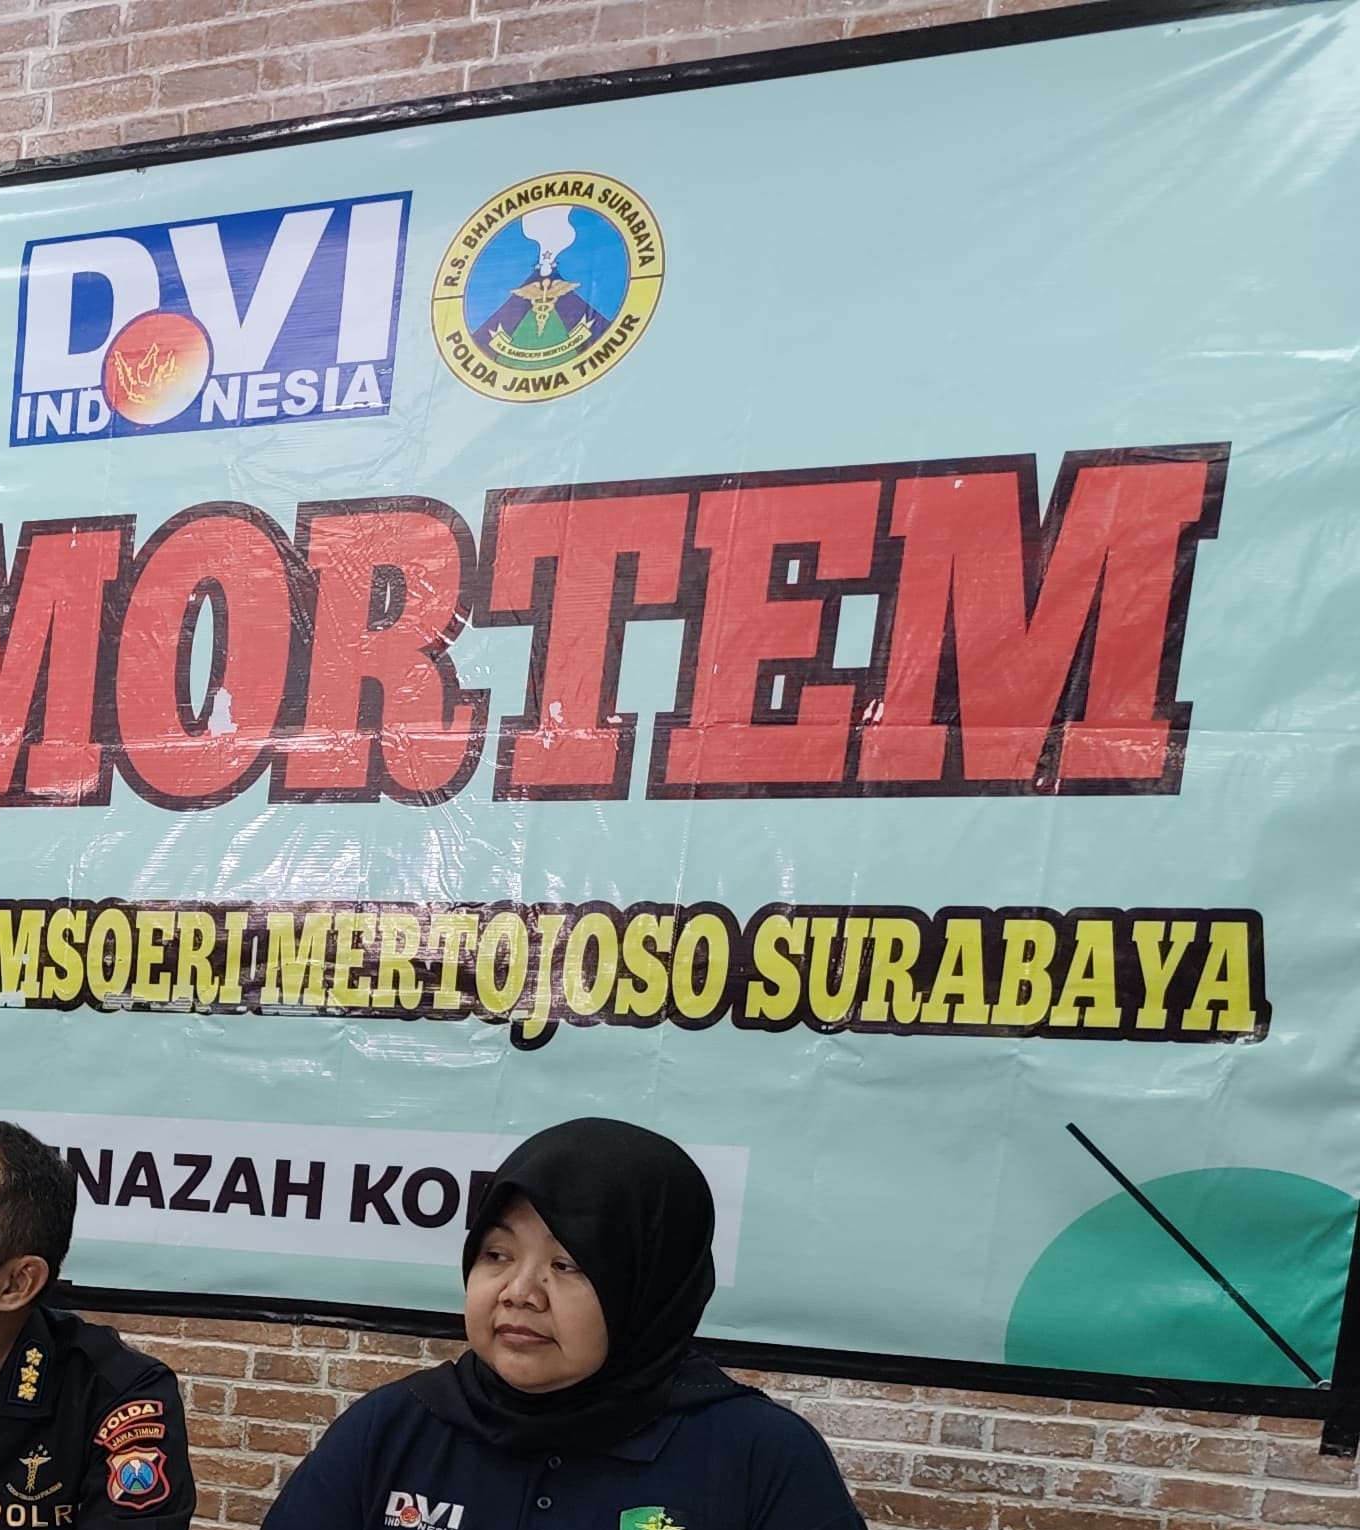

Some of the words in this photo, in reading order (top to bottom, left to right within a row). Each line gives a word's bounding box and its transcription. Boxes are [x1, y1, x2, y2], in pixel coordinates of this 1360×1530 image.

[443, 253, 469, 287] R.S.
[462, 180, 595, 250] BHAYANGKARA
[597, 187, 656, 268] SURABAYA
[21, 199, 404, 394] DVI
[445, 330, 499, 388] POLDA
[502, 371, 570, 394] JAWA
[572, 312, 641, 378] TIMUR
[261, 906, 730, 1040] MERTOJOSO
[744, 912, 1257, 1034] SURABAYA
[53, 1146, 326, 1221] NAZAH
[348, 1162, 497, 1231] KO
[98, 1403, 156, 1440] POLDA
[111, 1431, 134, 1448] JAWA
[134, 1426, 160, 1437] TIMUR
[385, 1490, 465, 1530] DVI
